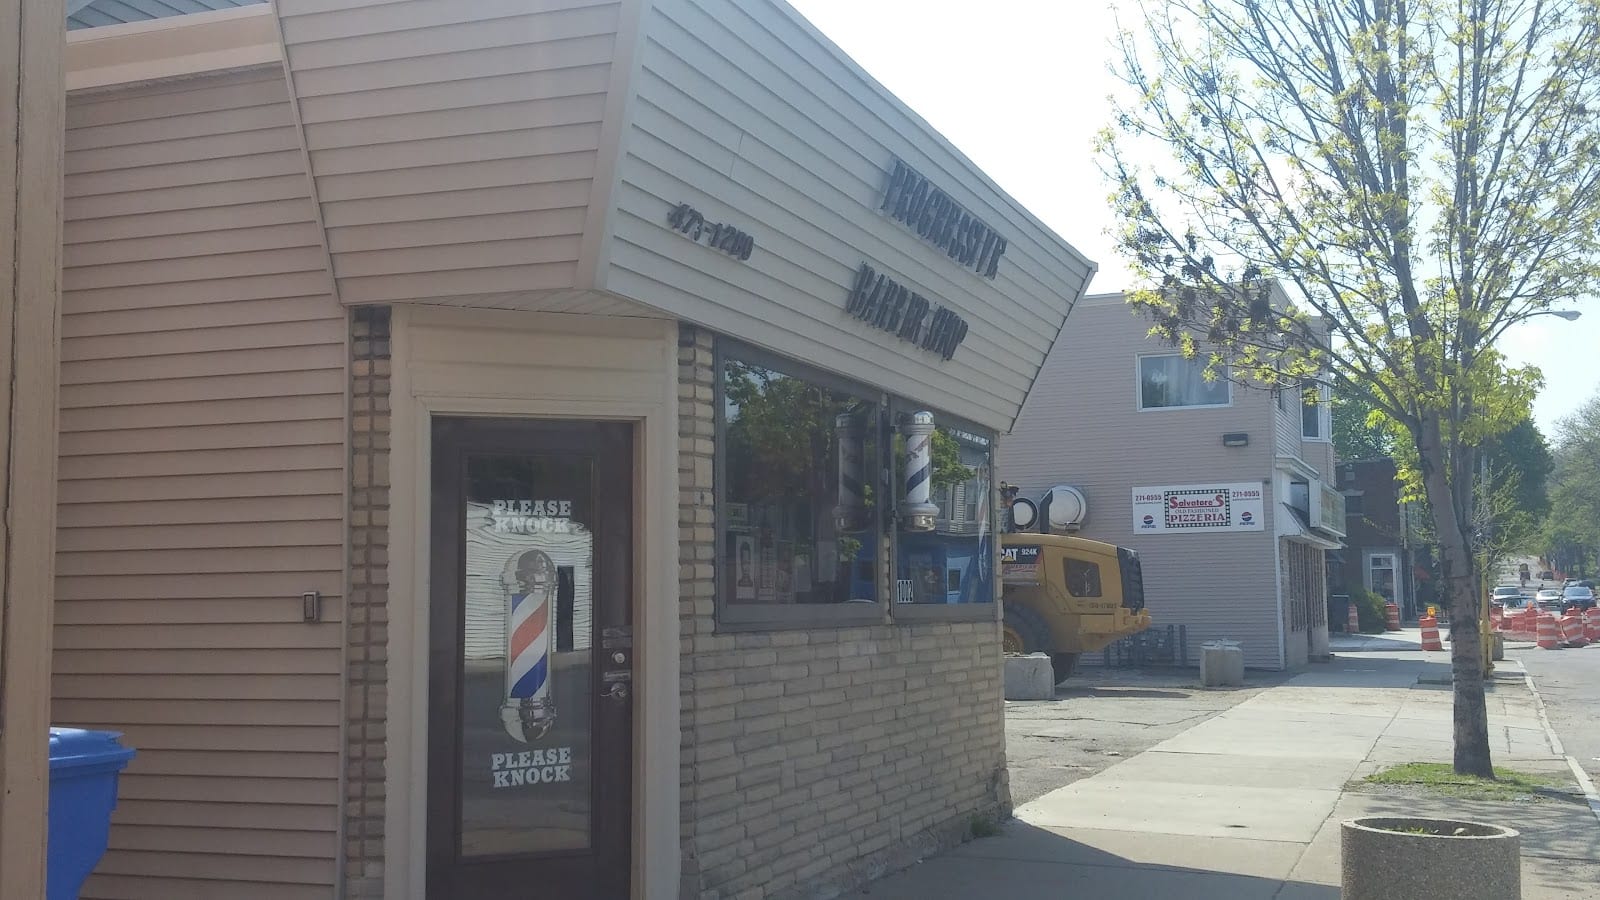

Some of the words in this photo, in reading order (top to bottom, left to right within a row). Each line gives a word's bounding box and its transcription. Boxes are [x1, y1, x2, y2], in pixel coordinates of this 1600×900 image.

[880, 158, 1008, 281] PROGRESSIVE
[492, 500, 572, 517] PLEASE
[494, 516, 571, 534] KNOCK
[1170, 513, 1226, 523] PIZZERIA
[1001, 548, 1018, 561] CAT
[1021, 548, 1038, 556] 924K
[491, 747, 572, 770] PLEASE
[492, 764, 571, 788] KNOCK
